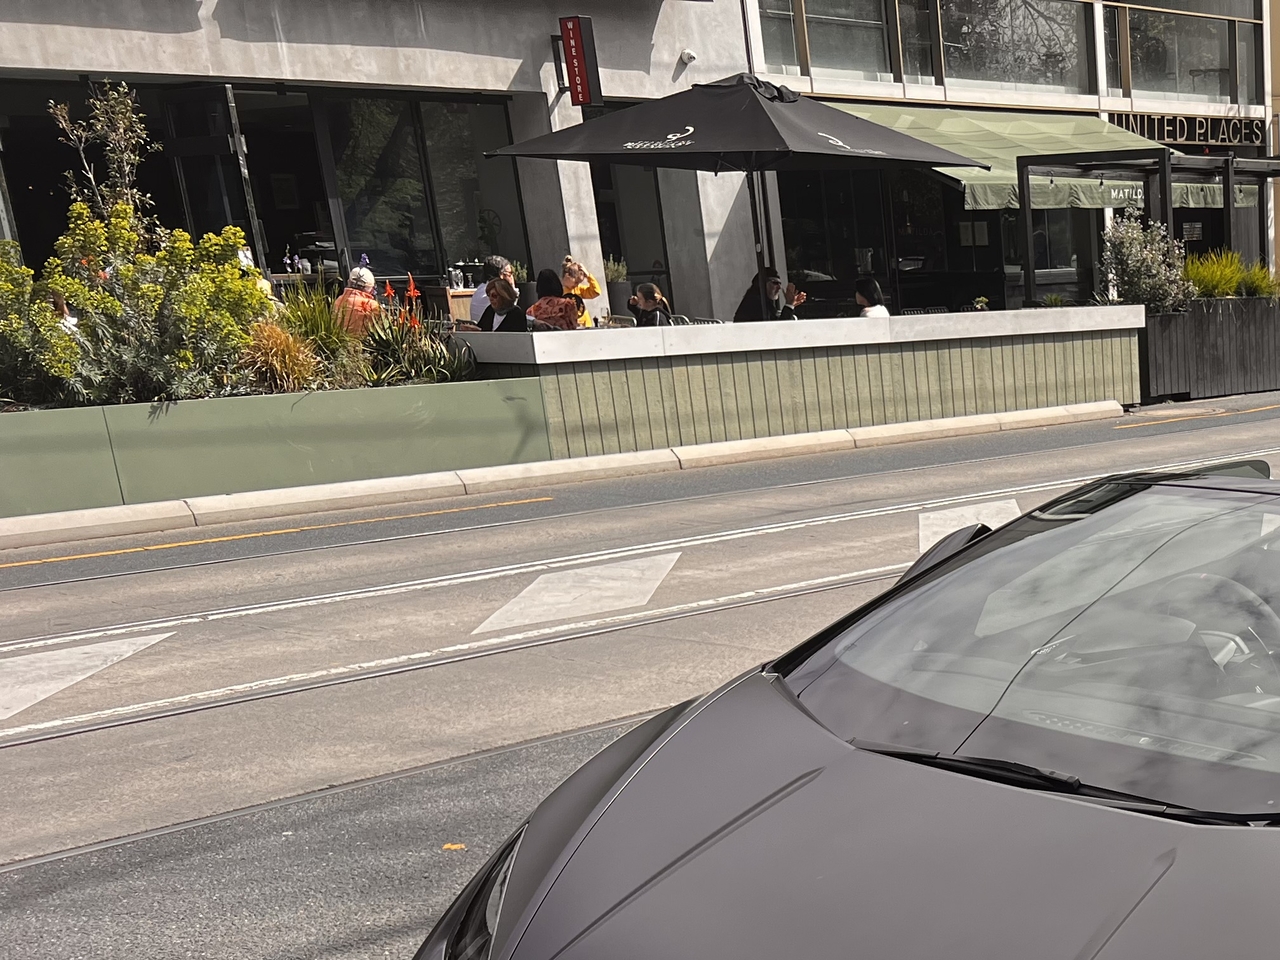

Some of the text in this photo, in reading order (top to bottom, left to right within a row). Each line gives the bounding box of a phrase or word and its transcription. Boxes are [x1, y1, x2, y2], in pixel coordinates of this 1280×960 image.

[567, 22, 583, 101] WINE STORE
[1196, 118, 1262, 144] PLACES
